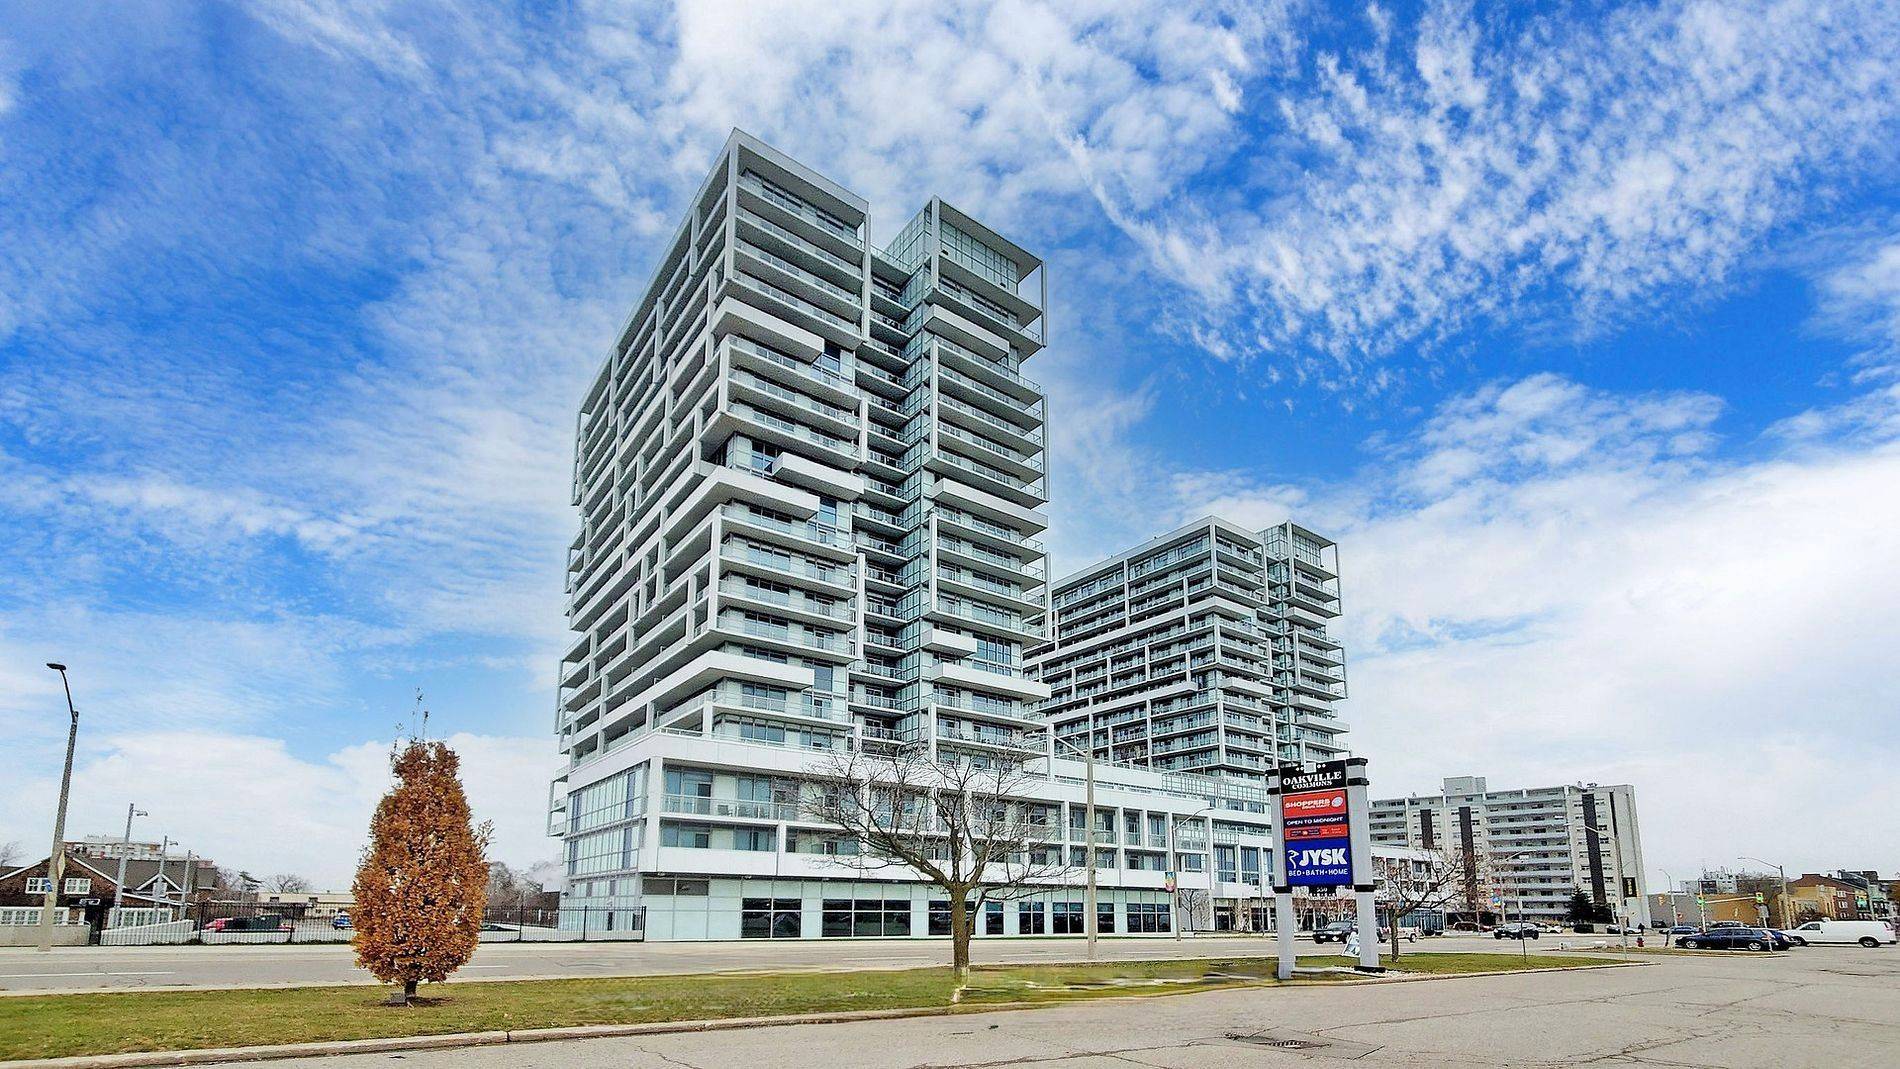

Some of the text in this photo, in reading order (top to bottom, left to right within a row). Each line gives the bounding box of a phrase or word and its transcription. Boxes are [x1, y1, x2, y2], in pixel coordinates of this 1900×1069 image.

[1282, 771, 1342, 786] OAKVILLE
[1292, 780, 1333, 790] COMMONS
[1285, 798, 1331, 808] SHOPPERS
[1299, 848, 1347, 867] JYSK
